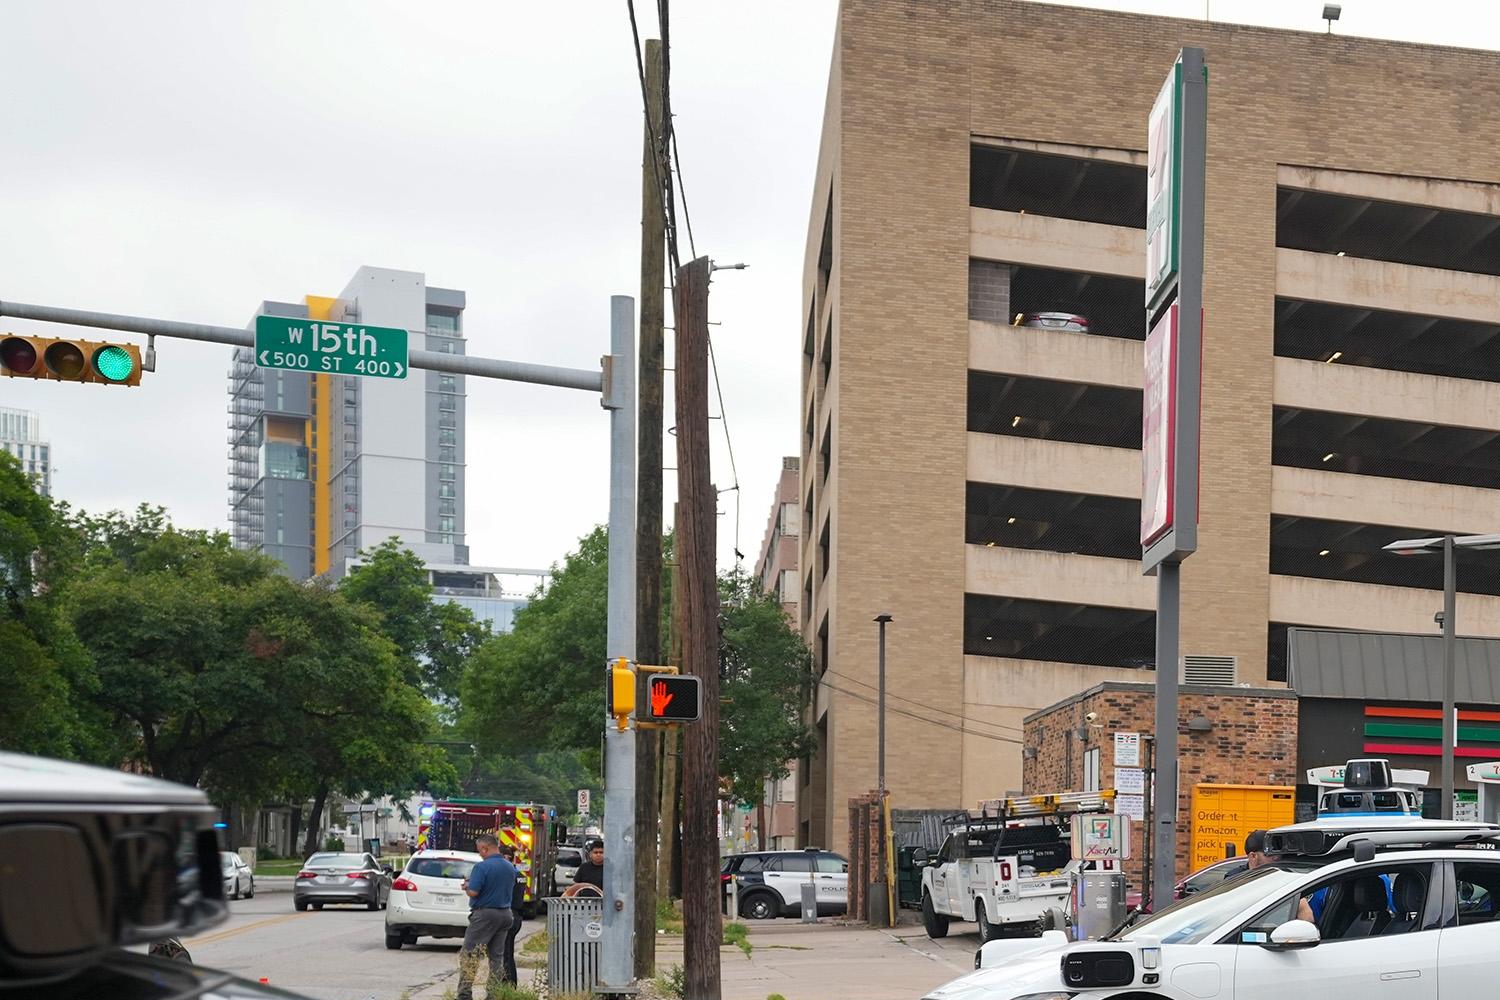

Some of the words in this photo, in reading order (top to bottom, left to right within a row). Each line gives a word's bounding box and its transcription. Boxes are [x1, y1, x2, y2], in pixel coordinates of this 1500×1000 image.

[288, 327, 304, 344] W
[310, 323, 377, 357] 15th
[273, 352, 309, 368] 500
[321, 356, 343, 371] ST
[355, 360, 390, 375] 400
[1470, 766, 1475, 774] 2
[1198, 811, 1225, 821] Order
[1198, 825, 1239, 836] Amazon,
[1197, 840, 1216, 850] pick
[1197, 854, 1218, 863] here
